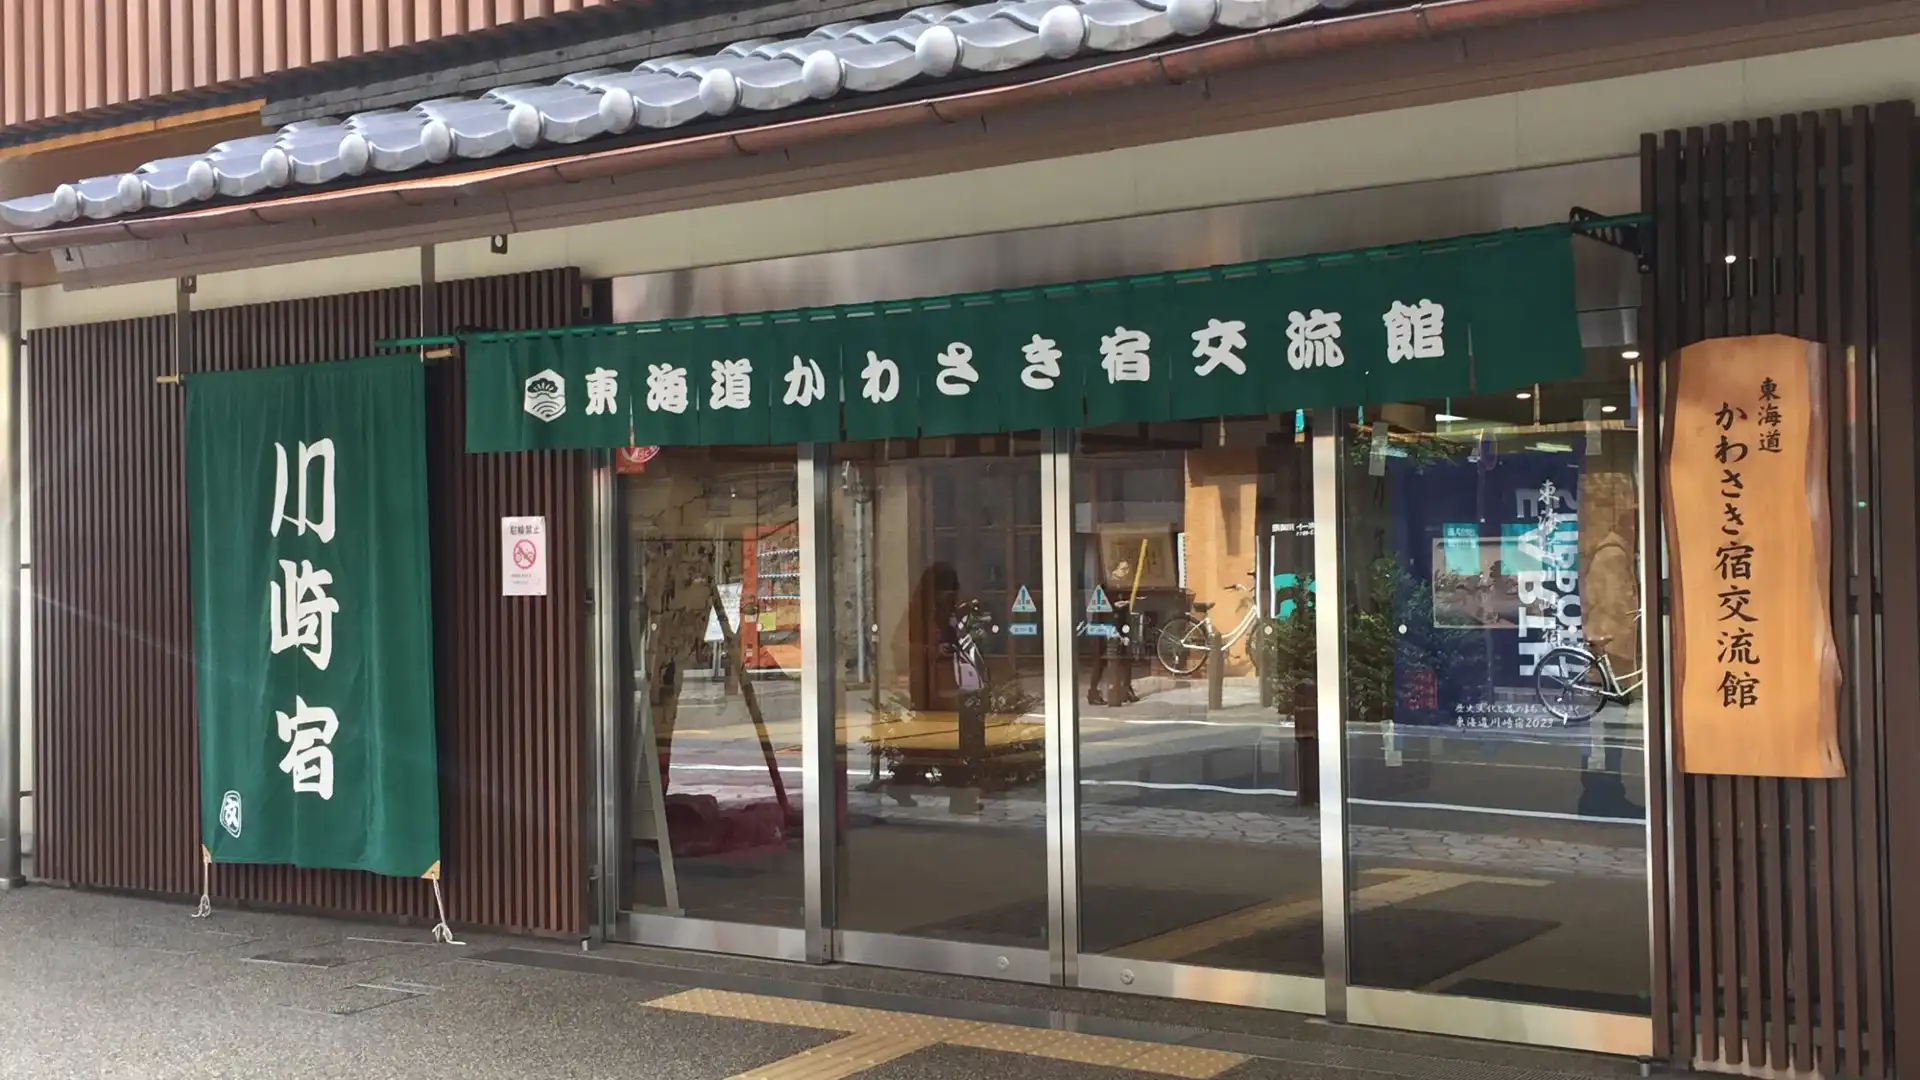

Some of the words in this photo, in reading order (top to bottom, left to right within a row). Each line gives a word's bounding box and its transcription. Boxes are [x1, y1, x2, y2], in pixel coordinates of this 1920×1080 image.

[585, 298, 1445, 415] 東海道かわさき宿交流館
[1757, 376, 1783, 454] 東海道
[1714, 402, 1760, 709] かわさき宿交流館
[270, 437, 340, 800] 川崎宿
[1456, 715, 1554, 729] 東海道川崎宿2023
